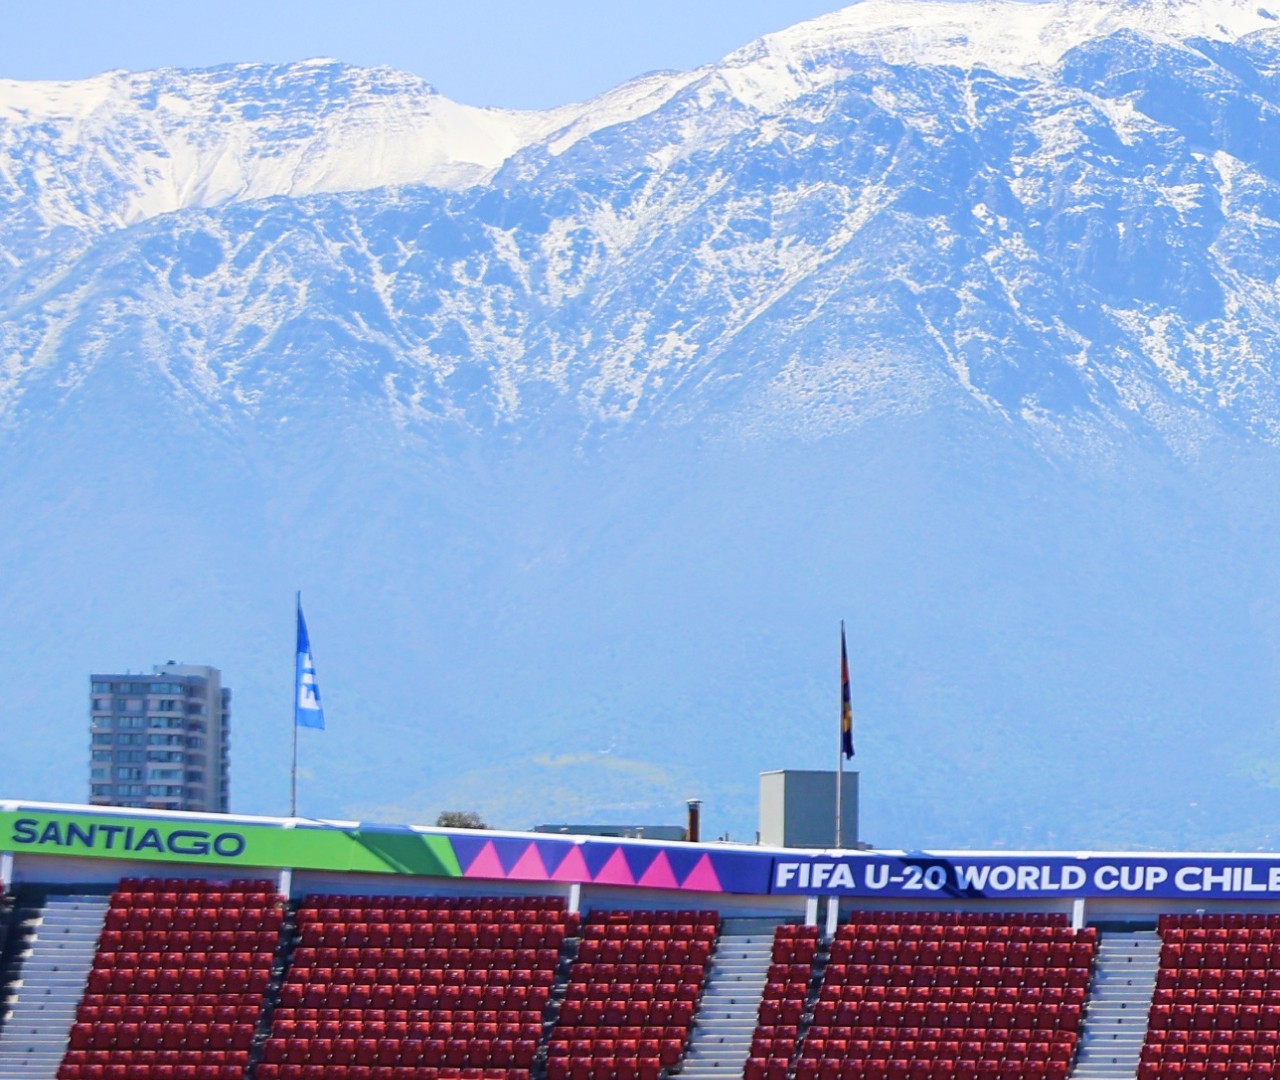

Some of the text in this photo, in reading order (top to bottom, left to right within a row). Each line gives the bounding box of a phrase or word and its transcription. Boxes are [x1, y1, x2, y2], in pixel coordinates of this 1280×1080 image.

[12, 818, 246, 857] SANTIAGO
[777, 863, 855, 888] FIFA
[865, 864, 945, 890] U-20
[955, 866, 1086, 890] WORLD
[1094, 866, 1167, 890] CUP
